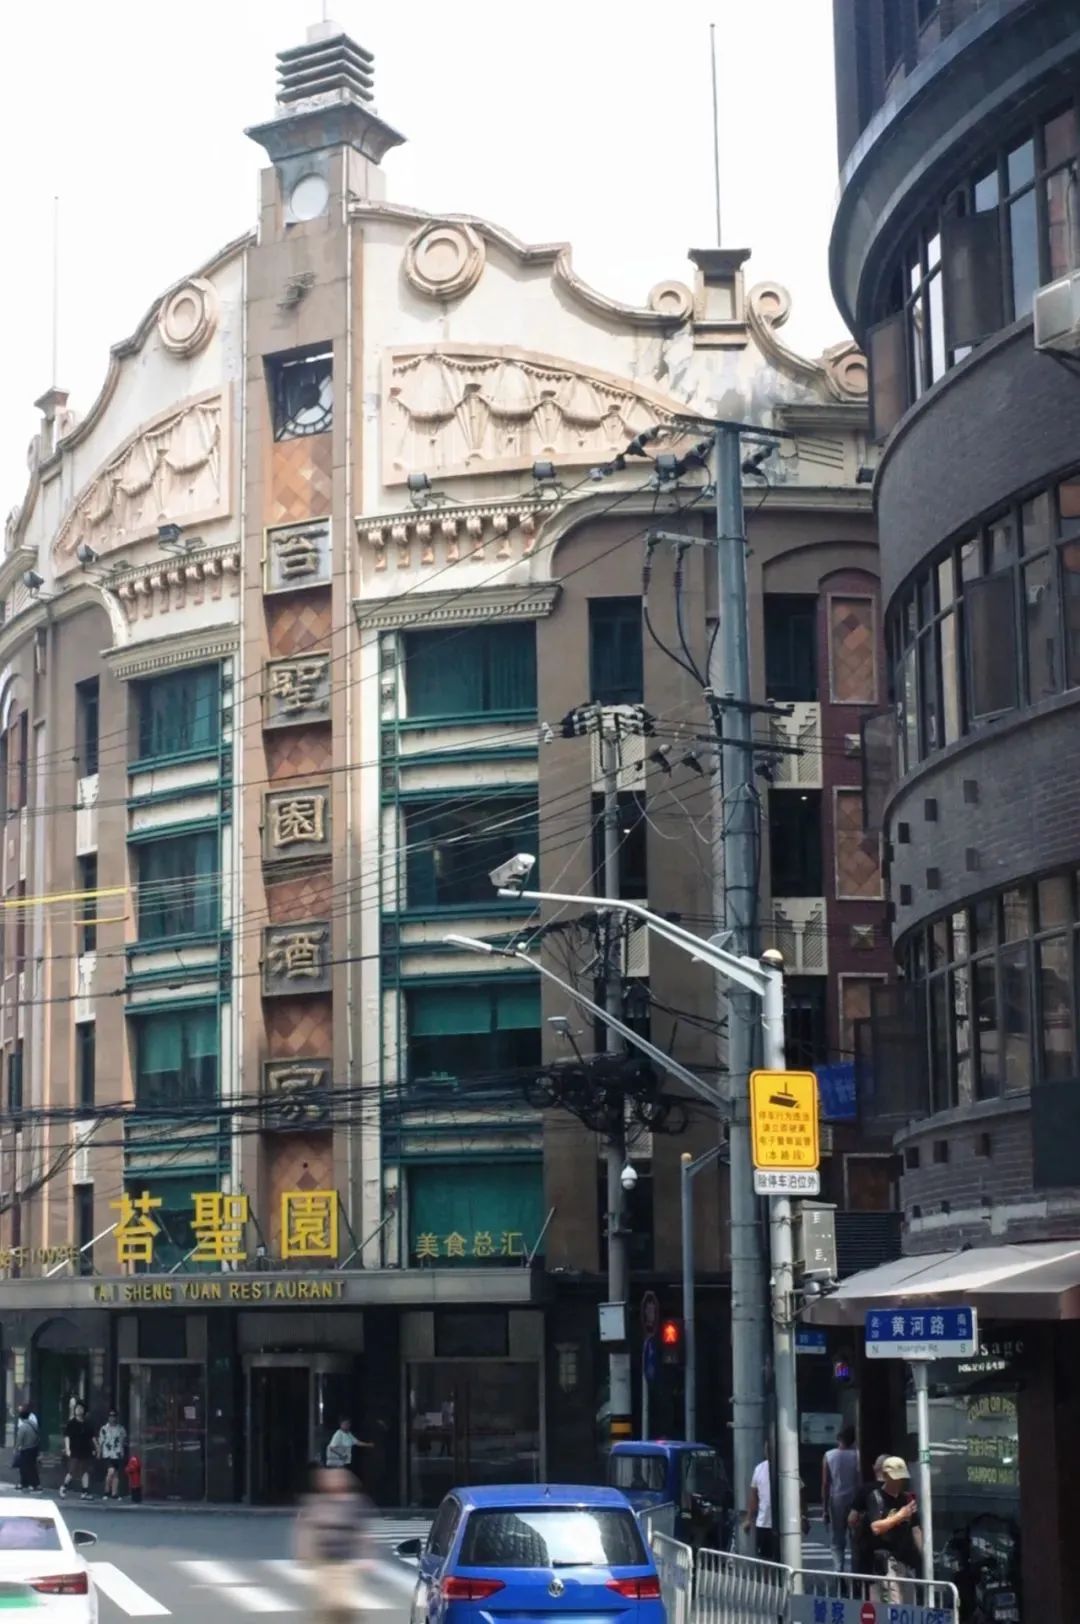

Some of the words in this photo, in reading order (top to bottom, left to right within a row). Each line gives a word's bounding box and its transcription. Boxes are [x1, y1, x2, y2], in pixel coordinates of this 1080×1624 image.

[110, 1190, 338, 1264] 苔聖園
[416, 1231, 523, 1258] 美食总汇
[125, 1284, 172, 1300] SHENG
[181, 1283, 221, 1299] YUAN
[230, 1280, 344, 1298] RESTAURANT
[891, 1315, 945, 1336] 黄河路
[960, 1343, 967, 1354] S
[980, 1339, 1024, 1357] sage
[890, 1607, 945, 1624] POLICE
